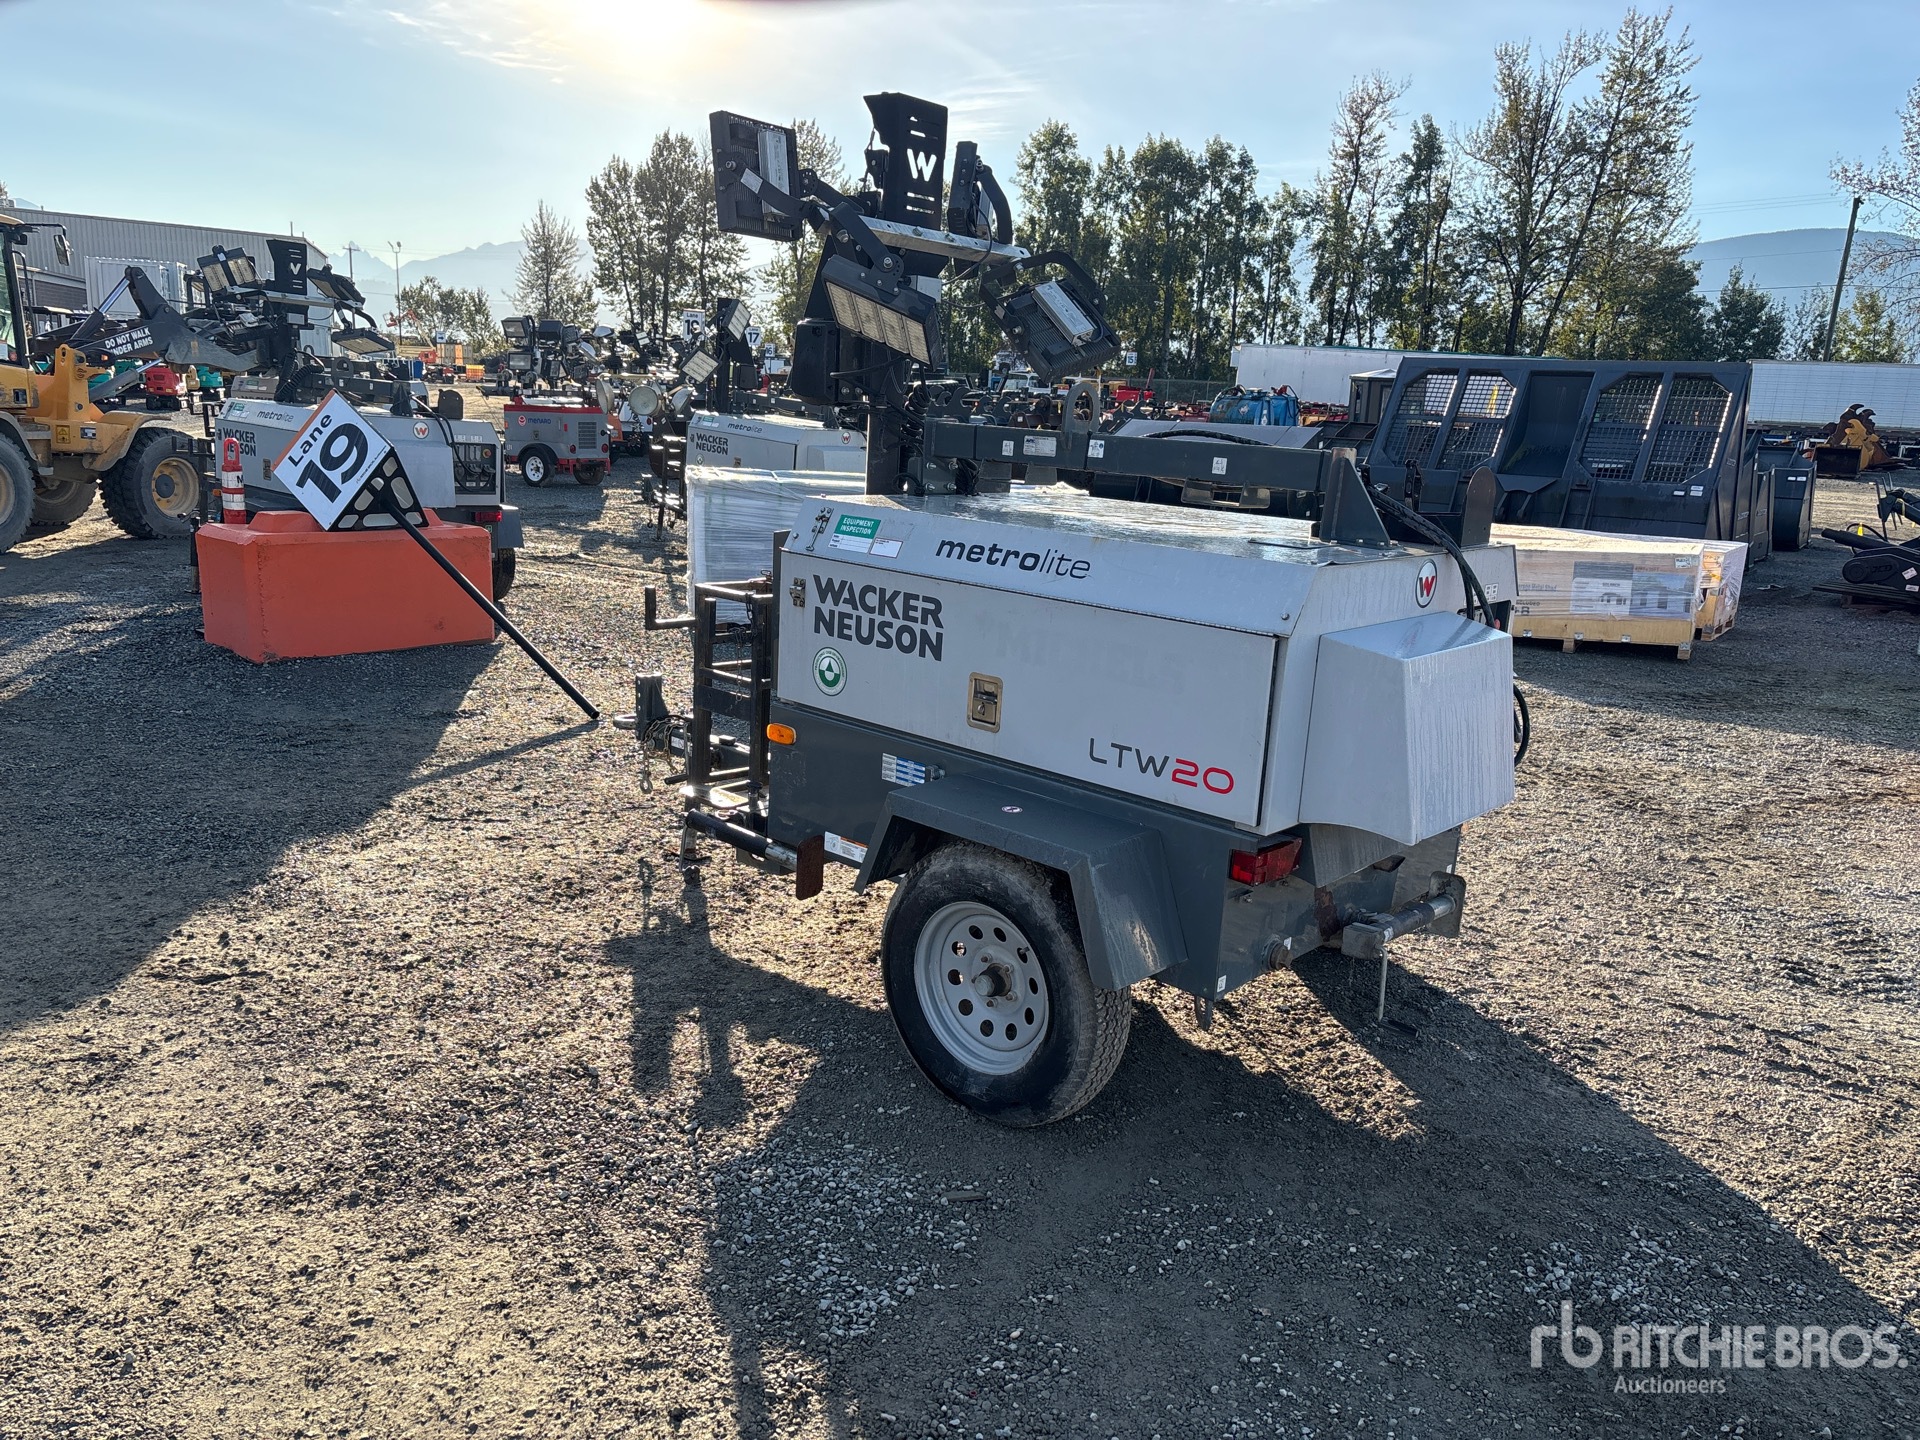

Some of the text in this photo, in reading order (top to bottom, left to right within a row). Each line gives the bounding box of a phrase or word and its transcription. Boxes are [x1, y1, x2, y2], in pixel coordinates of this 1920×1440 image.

[104, 327, 151, 349] DO NOT WALK
[133, 336, 154, 350] ARMS
[747, 331, 760, 343] 17
[765, 346, 773, 355] 16
[287, 414, 333, 467] Lane
[695, 441, 729, 456] NEUSON
[696, 432, 729, 447] WACKER
[295, 422, 369, 503] 19
[841, 524, 872, 535] INSPECTION
[843, 517, 875, 528] EQUIPMENT
[935, 539, 1092, 580] metrolite
[813, 574, 944, 629] WACKER
[814, 606, 944, 662] NEUSON
[1089, 737, 1234, 795] LTW20
